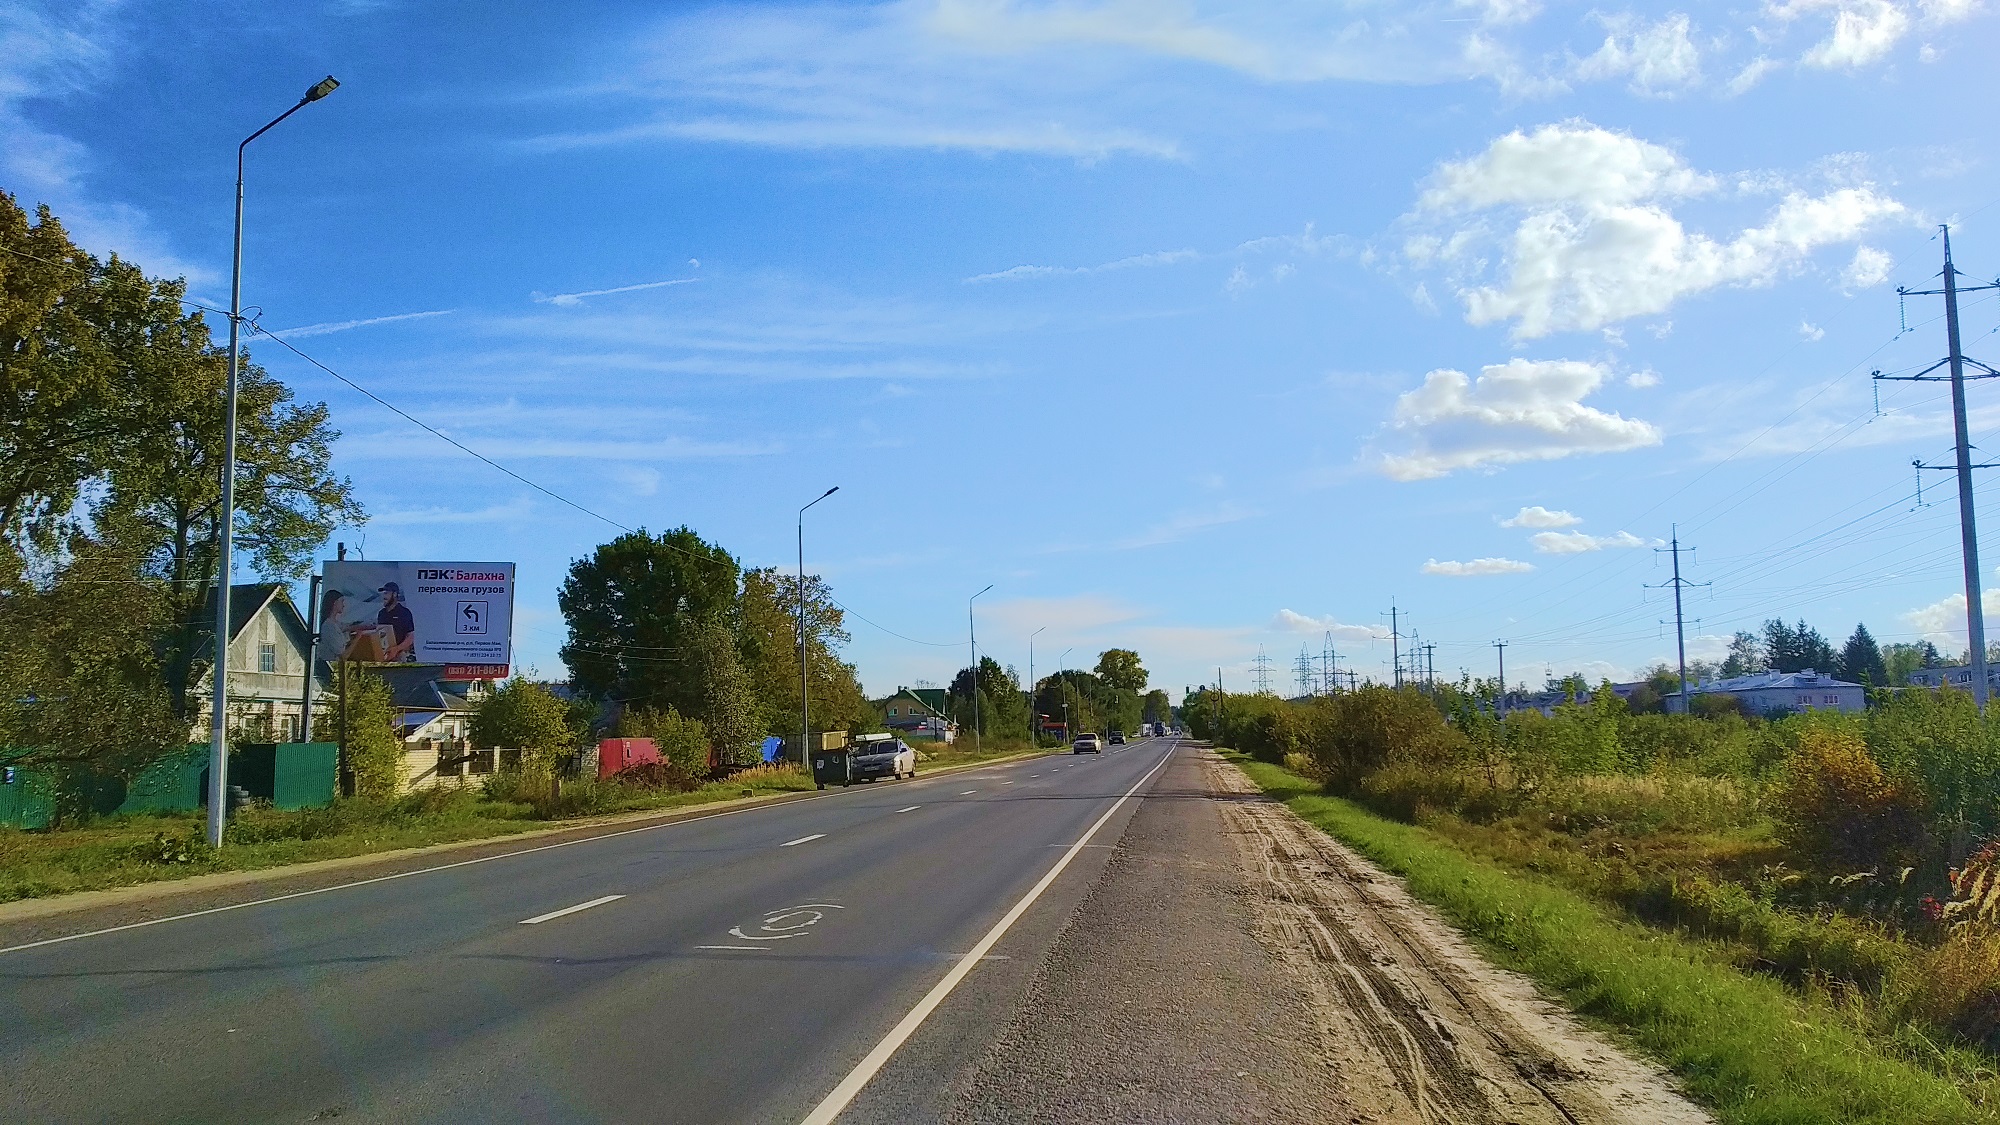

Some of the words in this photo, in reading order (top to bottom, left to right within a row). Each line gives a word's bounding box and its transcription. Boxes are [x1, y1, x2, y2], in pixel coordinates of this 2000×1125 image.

[456, 570, 505, 581] Балахна
[417, 586, 470, 594] перевозка
[471, 586, 505, 595] грузов
[466, 665, 506, 675] 211-80-17
